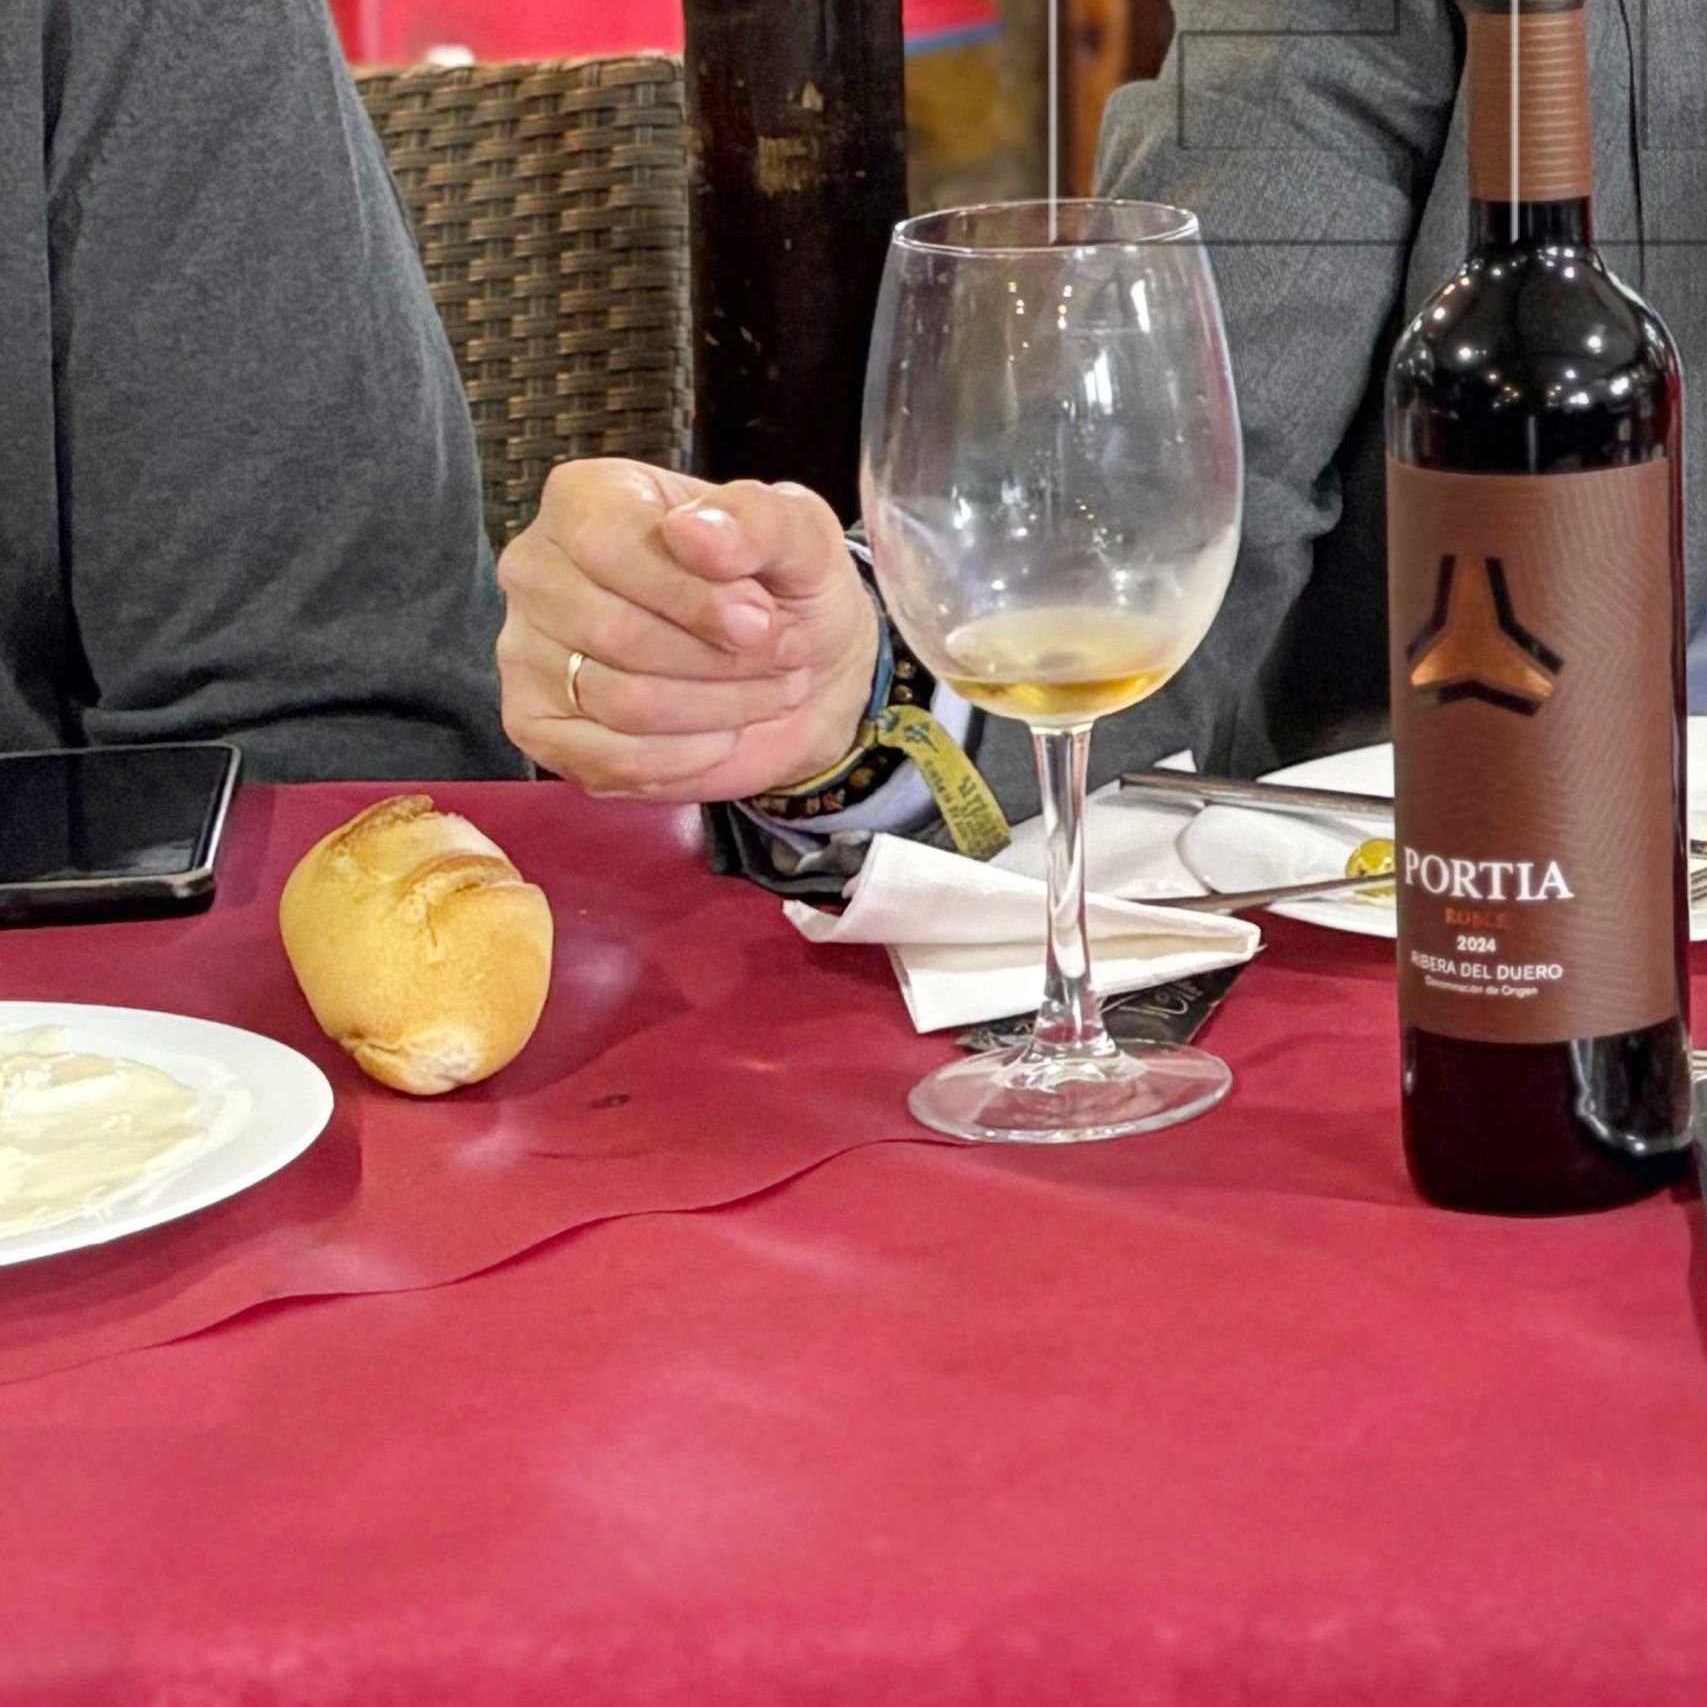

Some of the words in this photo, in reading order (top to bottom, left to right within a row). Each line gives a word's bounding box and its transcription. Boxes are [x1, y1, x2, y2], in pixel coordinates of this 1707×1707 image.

[1403, 846, 1576, 902] PORTIA
[1456, 934, 1497, 953] 2024
[1411, 949, 1457, 975] RIBERA
[1460, 962, 1493, 980] DEL
[1497, 962, 1564, 981] DUERO
